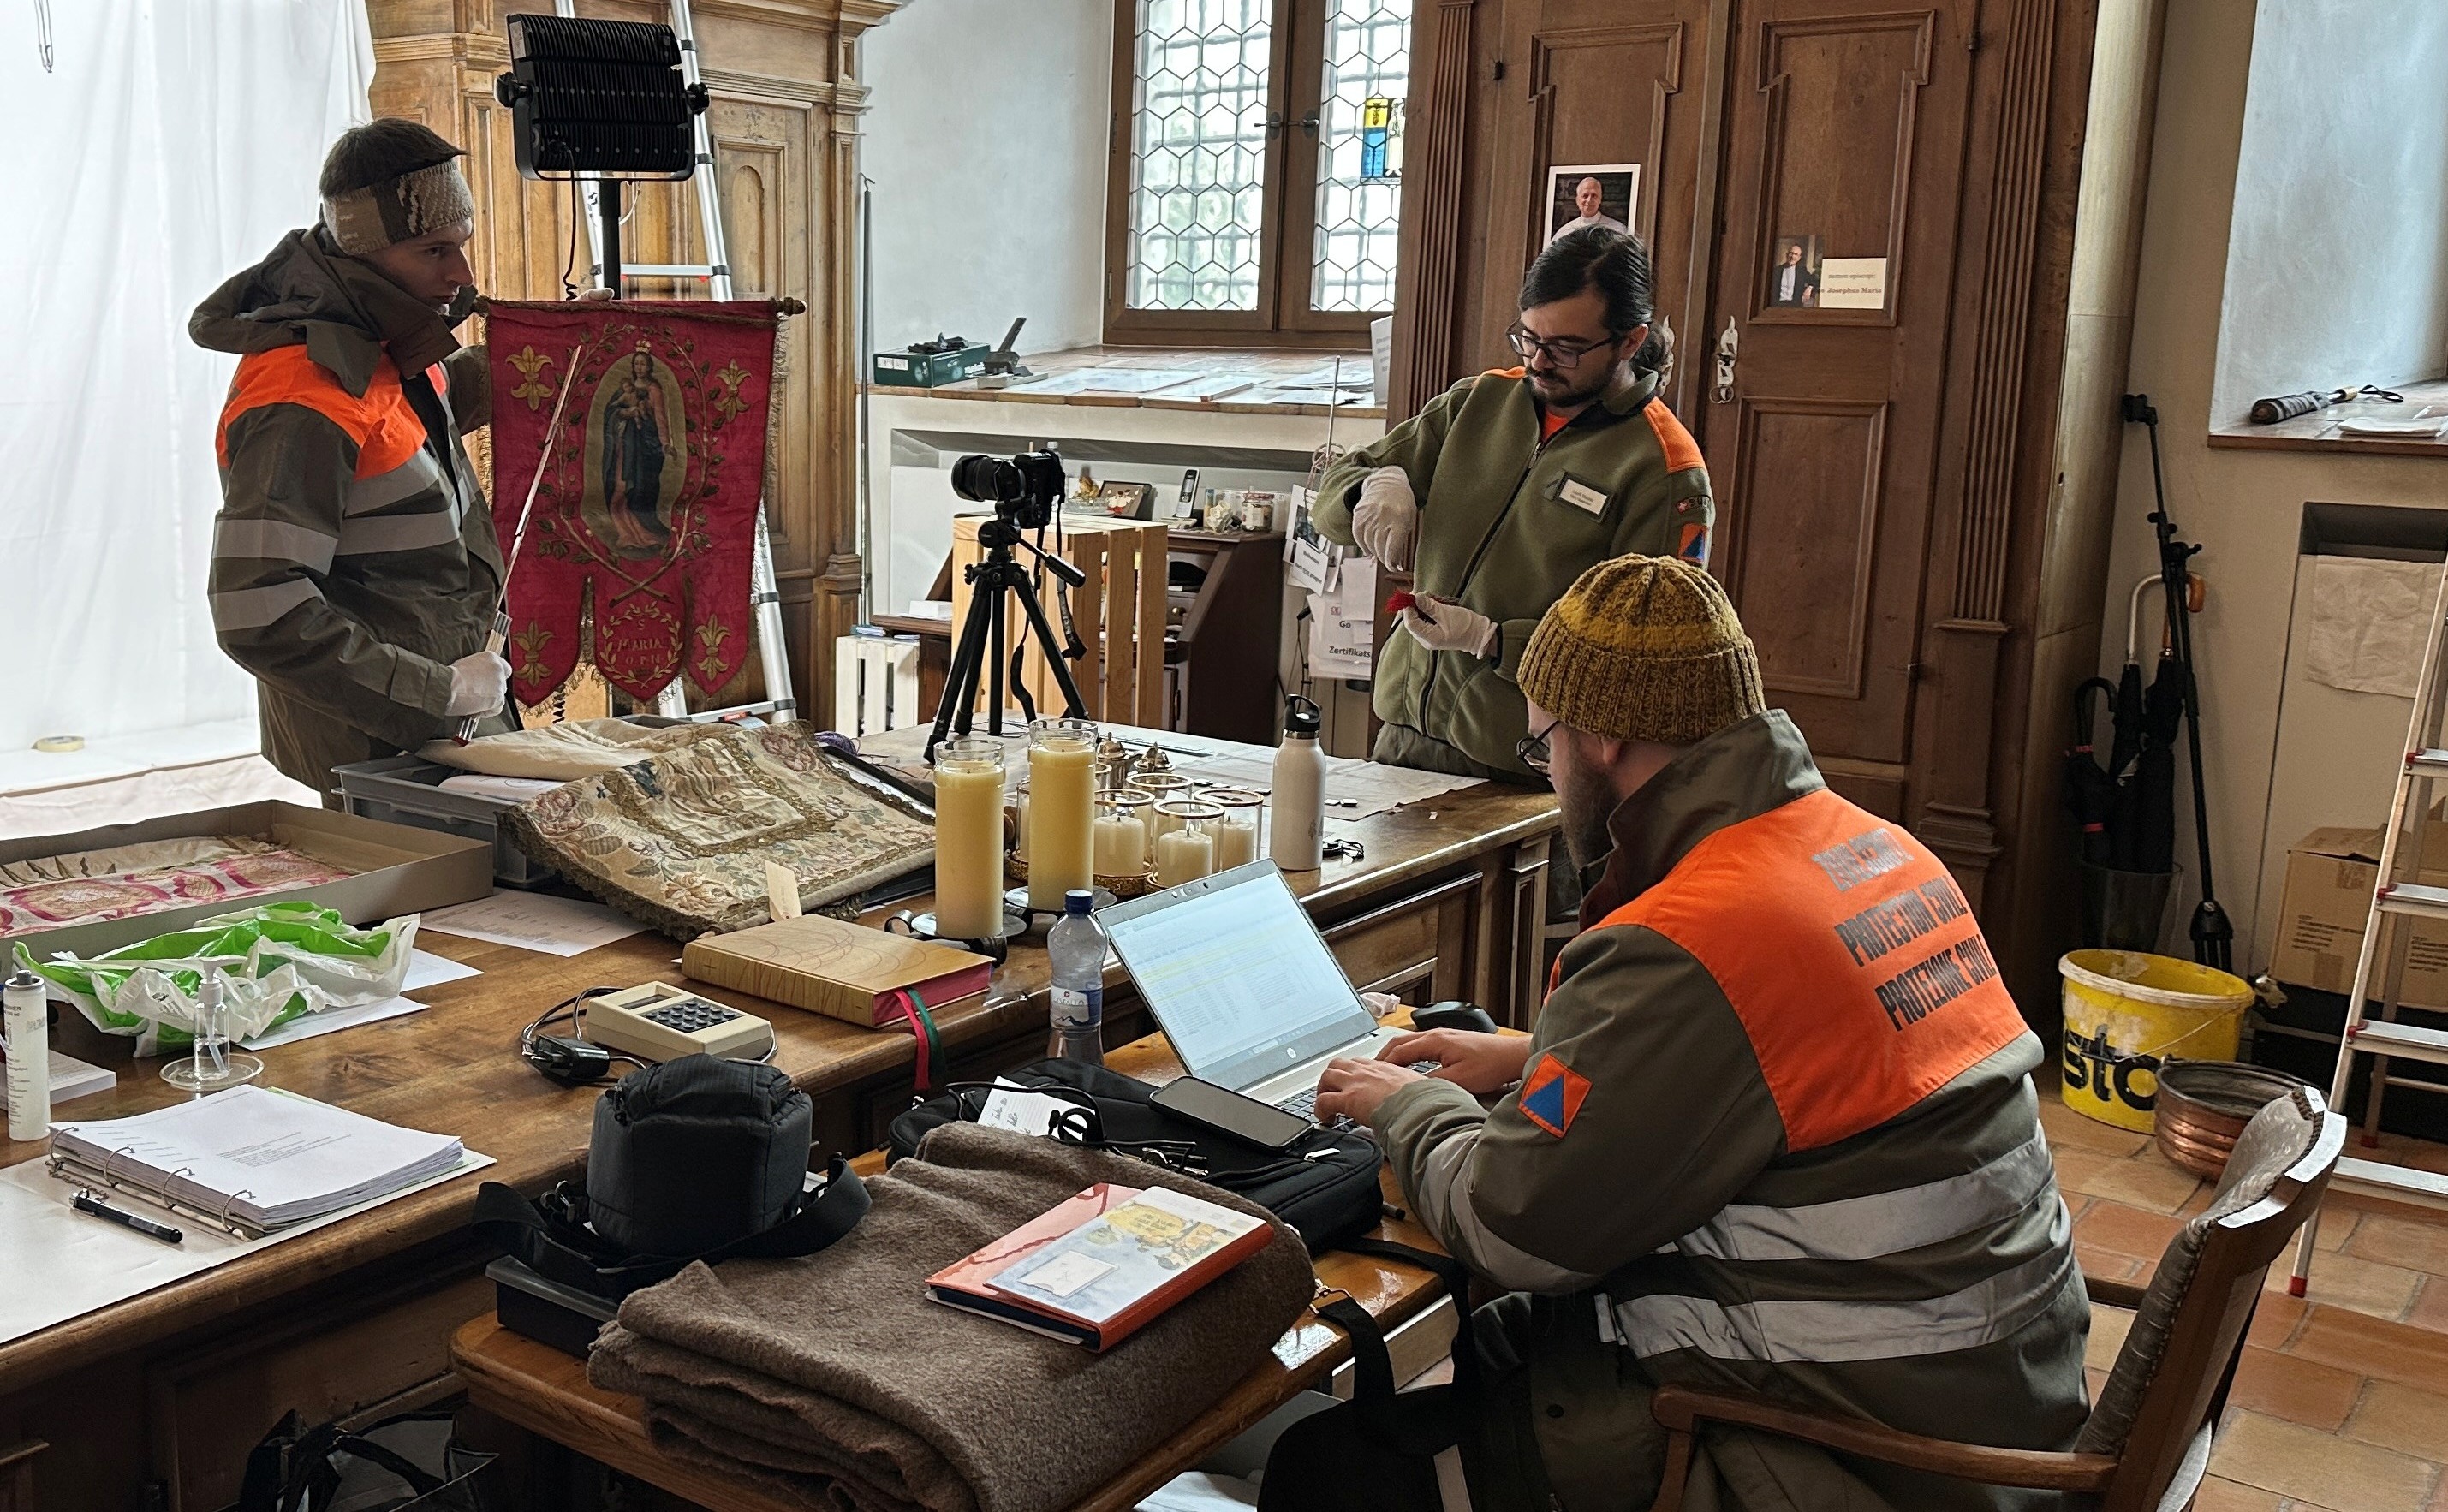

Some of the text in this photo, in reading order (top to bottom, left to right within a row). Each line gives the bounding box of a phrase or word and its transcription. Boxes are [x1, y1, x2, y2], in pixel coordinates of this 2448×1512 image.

[1339, 620, 1351, 628] Go
[617, 638, 663, 652] MARIA
[1329, 646, 1371, 658] Zertifikats
[1834, 874, 1969, 968] PROTECTION CIVILE
[1874, 933, 1998, 1032] PROTEZIONE CIVILE
